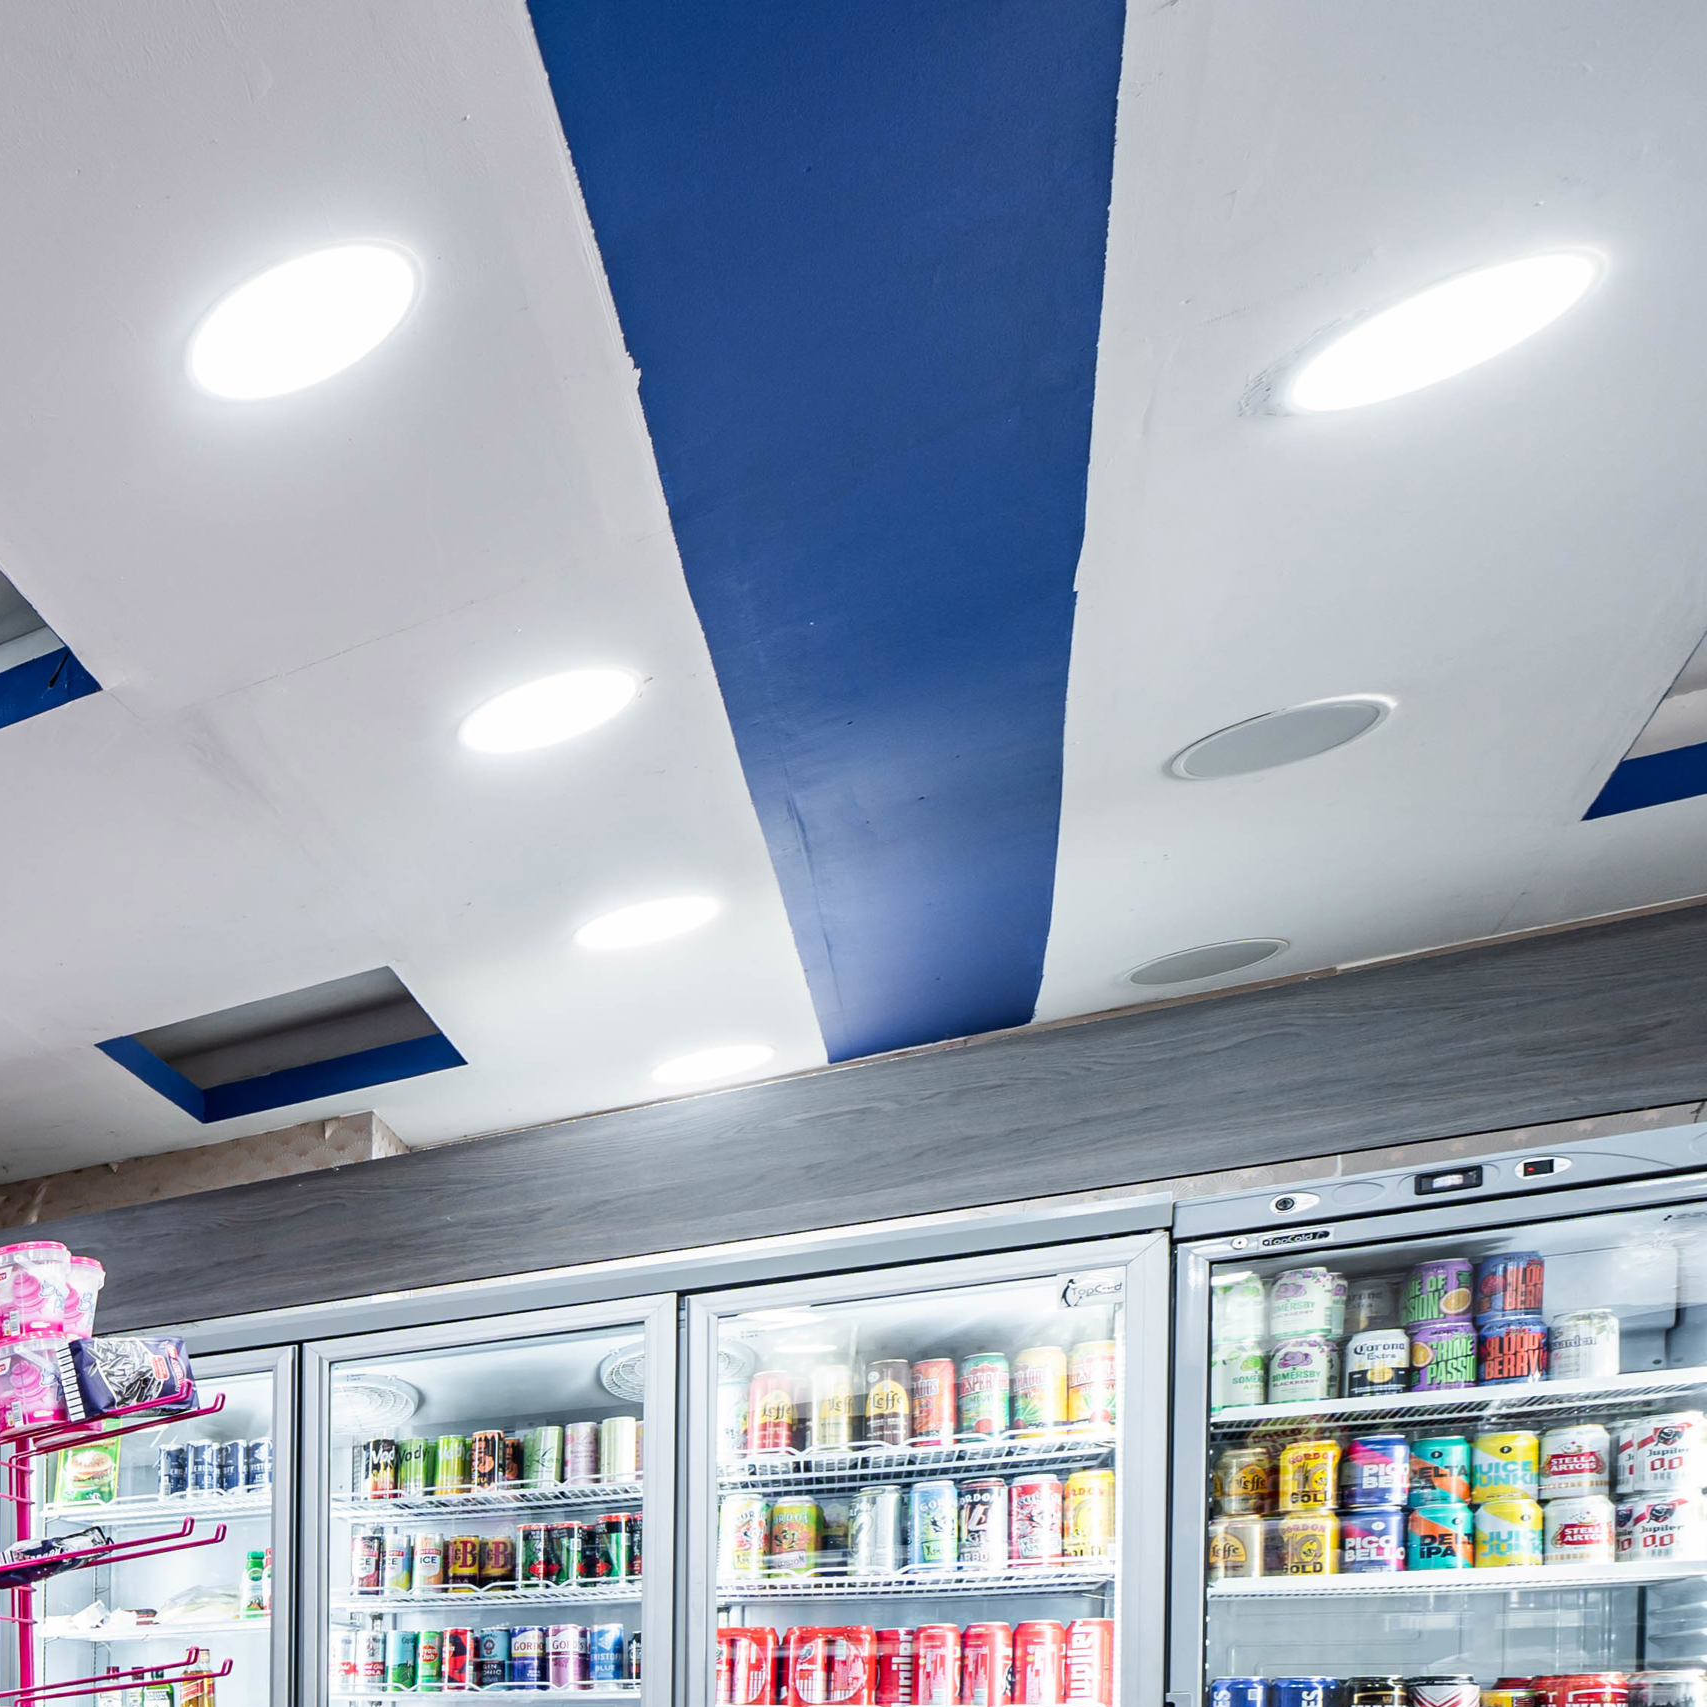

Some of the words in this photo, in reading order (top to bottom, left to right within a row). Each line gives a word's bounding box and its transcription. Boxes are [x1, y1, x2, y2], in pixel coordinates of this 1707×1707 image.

[1262, 1231, 1315, 1247] TopCold
[1353, 1340, 1407, 1358] Corona
[1485, 1331, 1544, 1360] BLOODY
[1366, 1351, 1398, 1362] Extra
[1549, 1461, 1598, 1475] ARTOIS
[1550, 1453, 1597, 1467] STELLA
[1289, 1490, 1328, 1504] GOLD
[1344, 1535, 1392, 1552] PICO
[1344, 1547, 1406, 1563] BELLO
